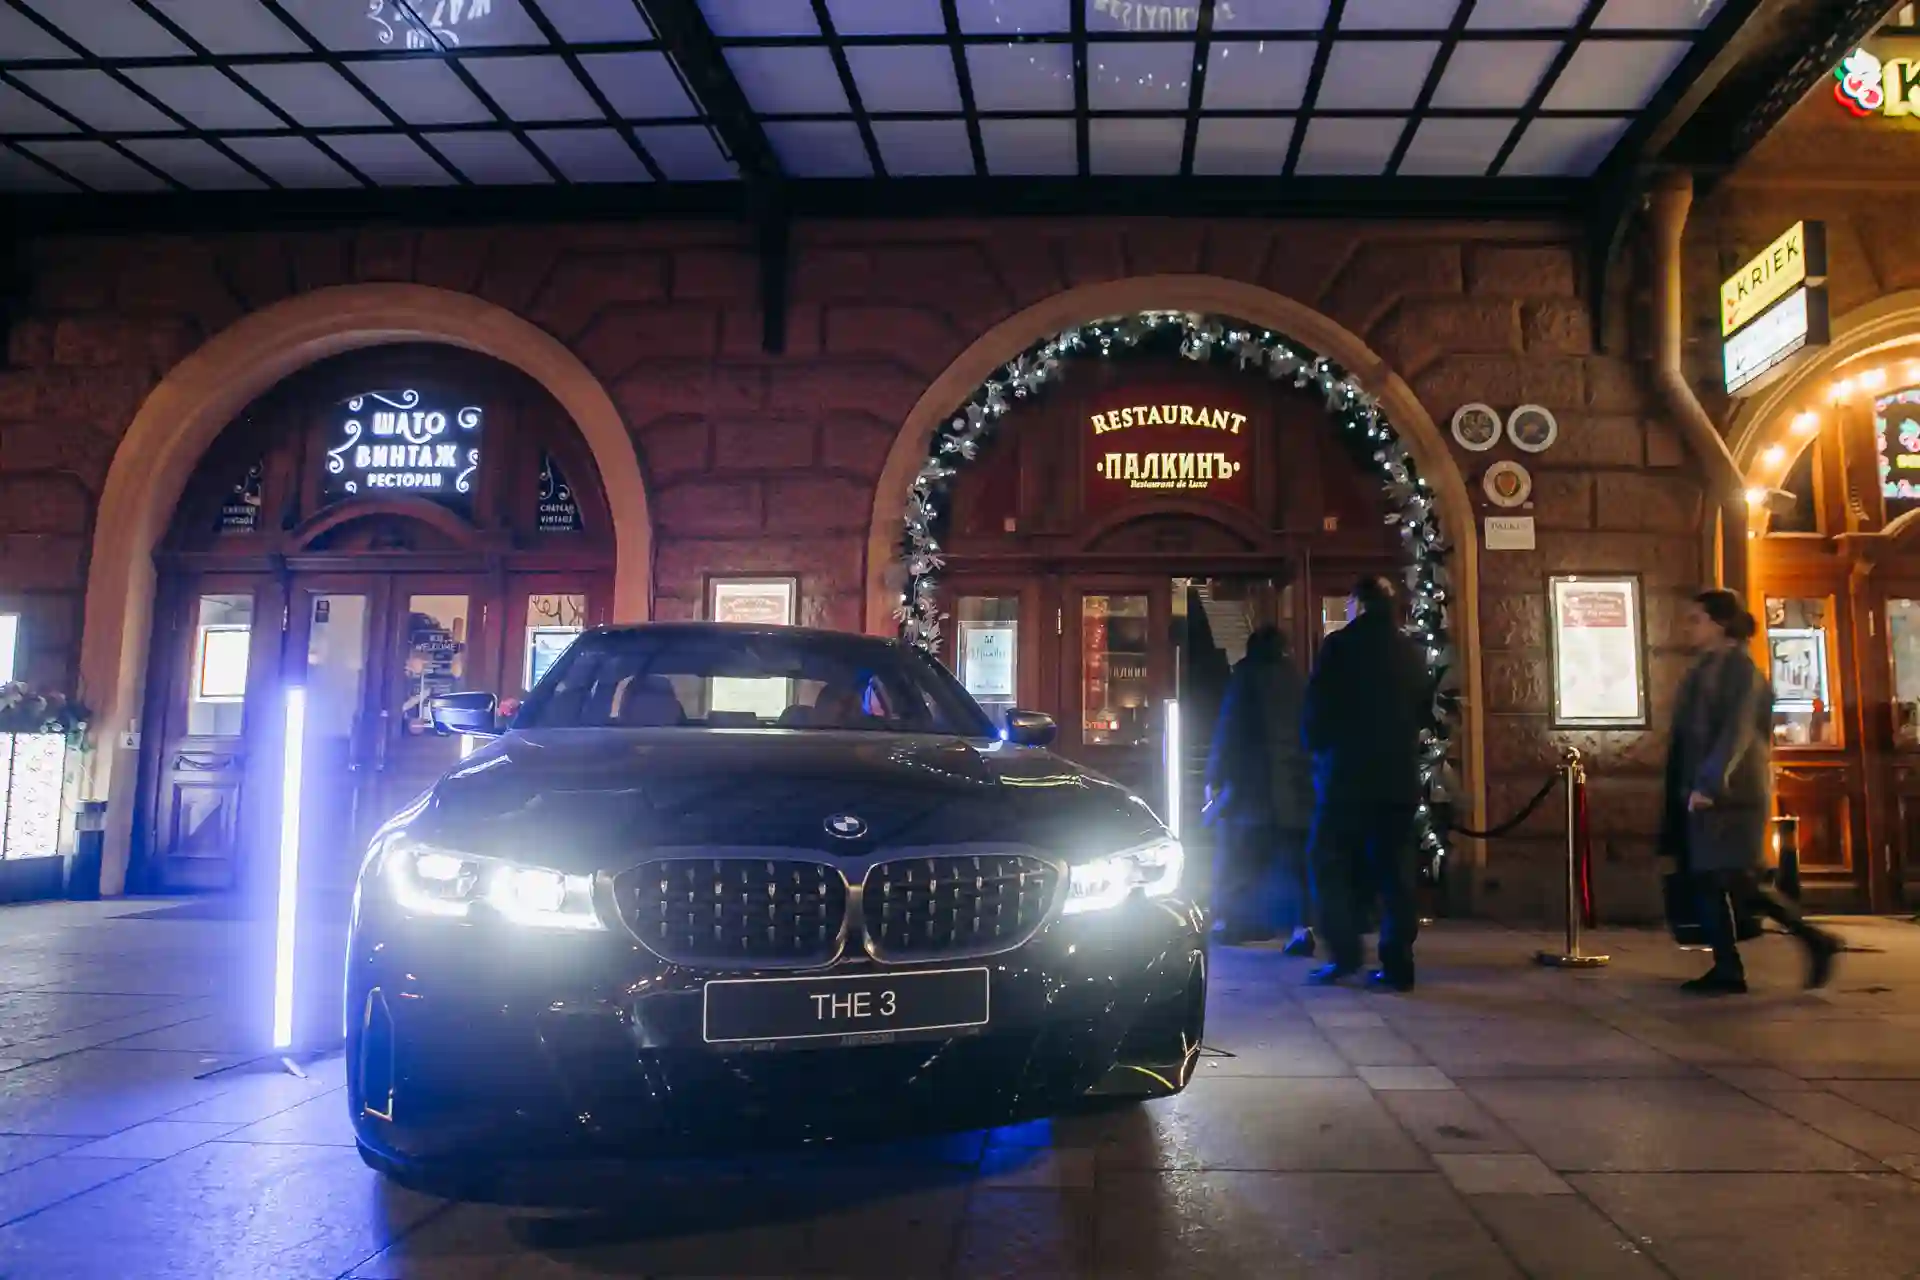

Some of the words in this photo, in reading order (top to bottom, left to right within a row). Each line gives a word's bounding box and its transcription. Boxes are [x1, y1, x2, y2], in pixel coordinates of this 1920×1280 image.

[1737, 234, 1800, 302] KRIEK
[372, 411, 446, 444] ШАТО
[1090, 404, 1247, 435] RESTAURANT
[355, 440, 458, 468] ВИНТАЖ
[366, 472, 443, 488] РЕСТОРАН
[1130, 479, 1175, 489] Restaurant
[1176, 480, 1187, 489] de
[1188, 480, 1209, 489] Luxe
[810, 991, 871, 1020] THE
[879, 990, 897, 1016] 3
